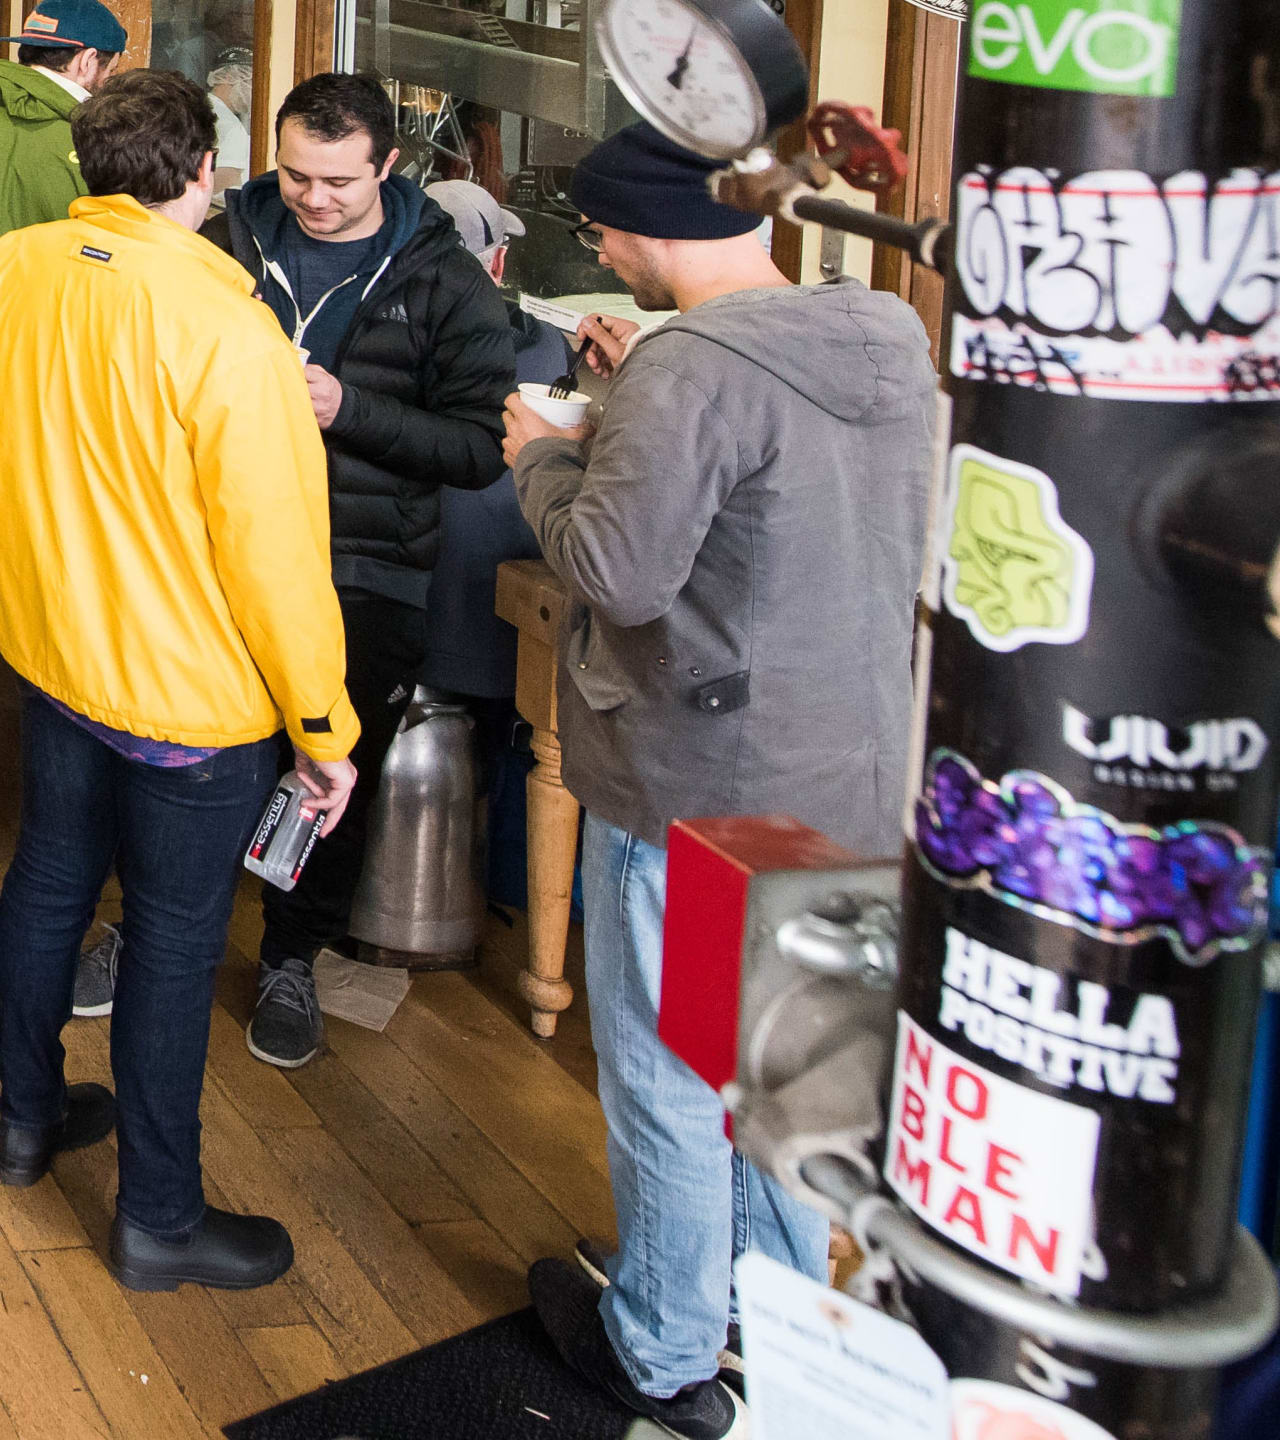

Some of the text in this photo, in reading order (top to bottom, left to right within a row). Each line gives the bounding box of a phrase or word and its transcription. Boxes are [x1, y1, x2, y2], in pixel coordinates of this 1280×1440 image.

[972, 1, 1169, 82] evo
[939, 991, 1179, 1105] POSITIVE
[941, 925, 1182, 1060] HELLA
